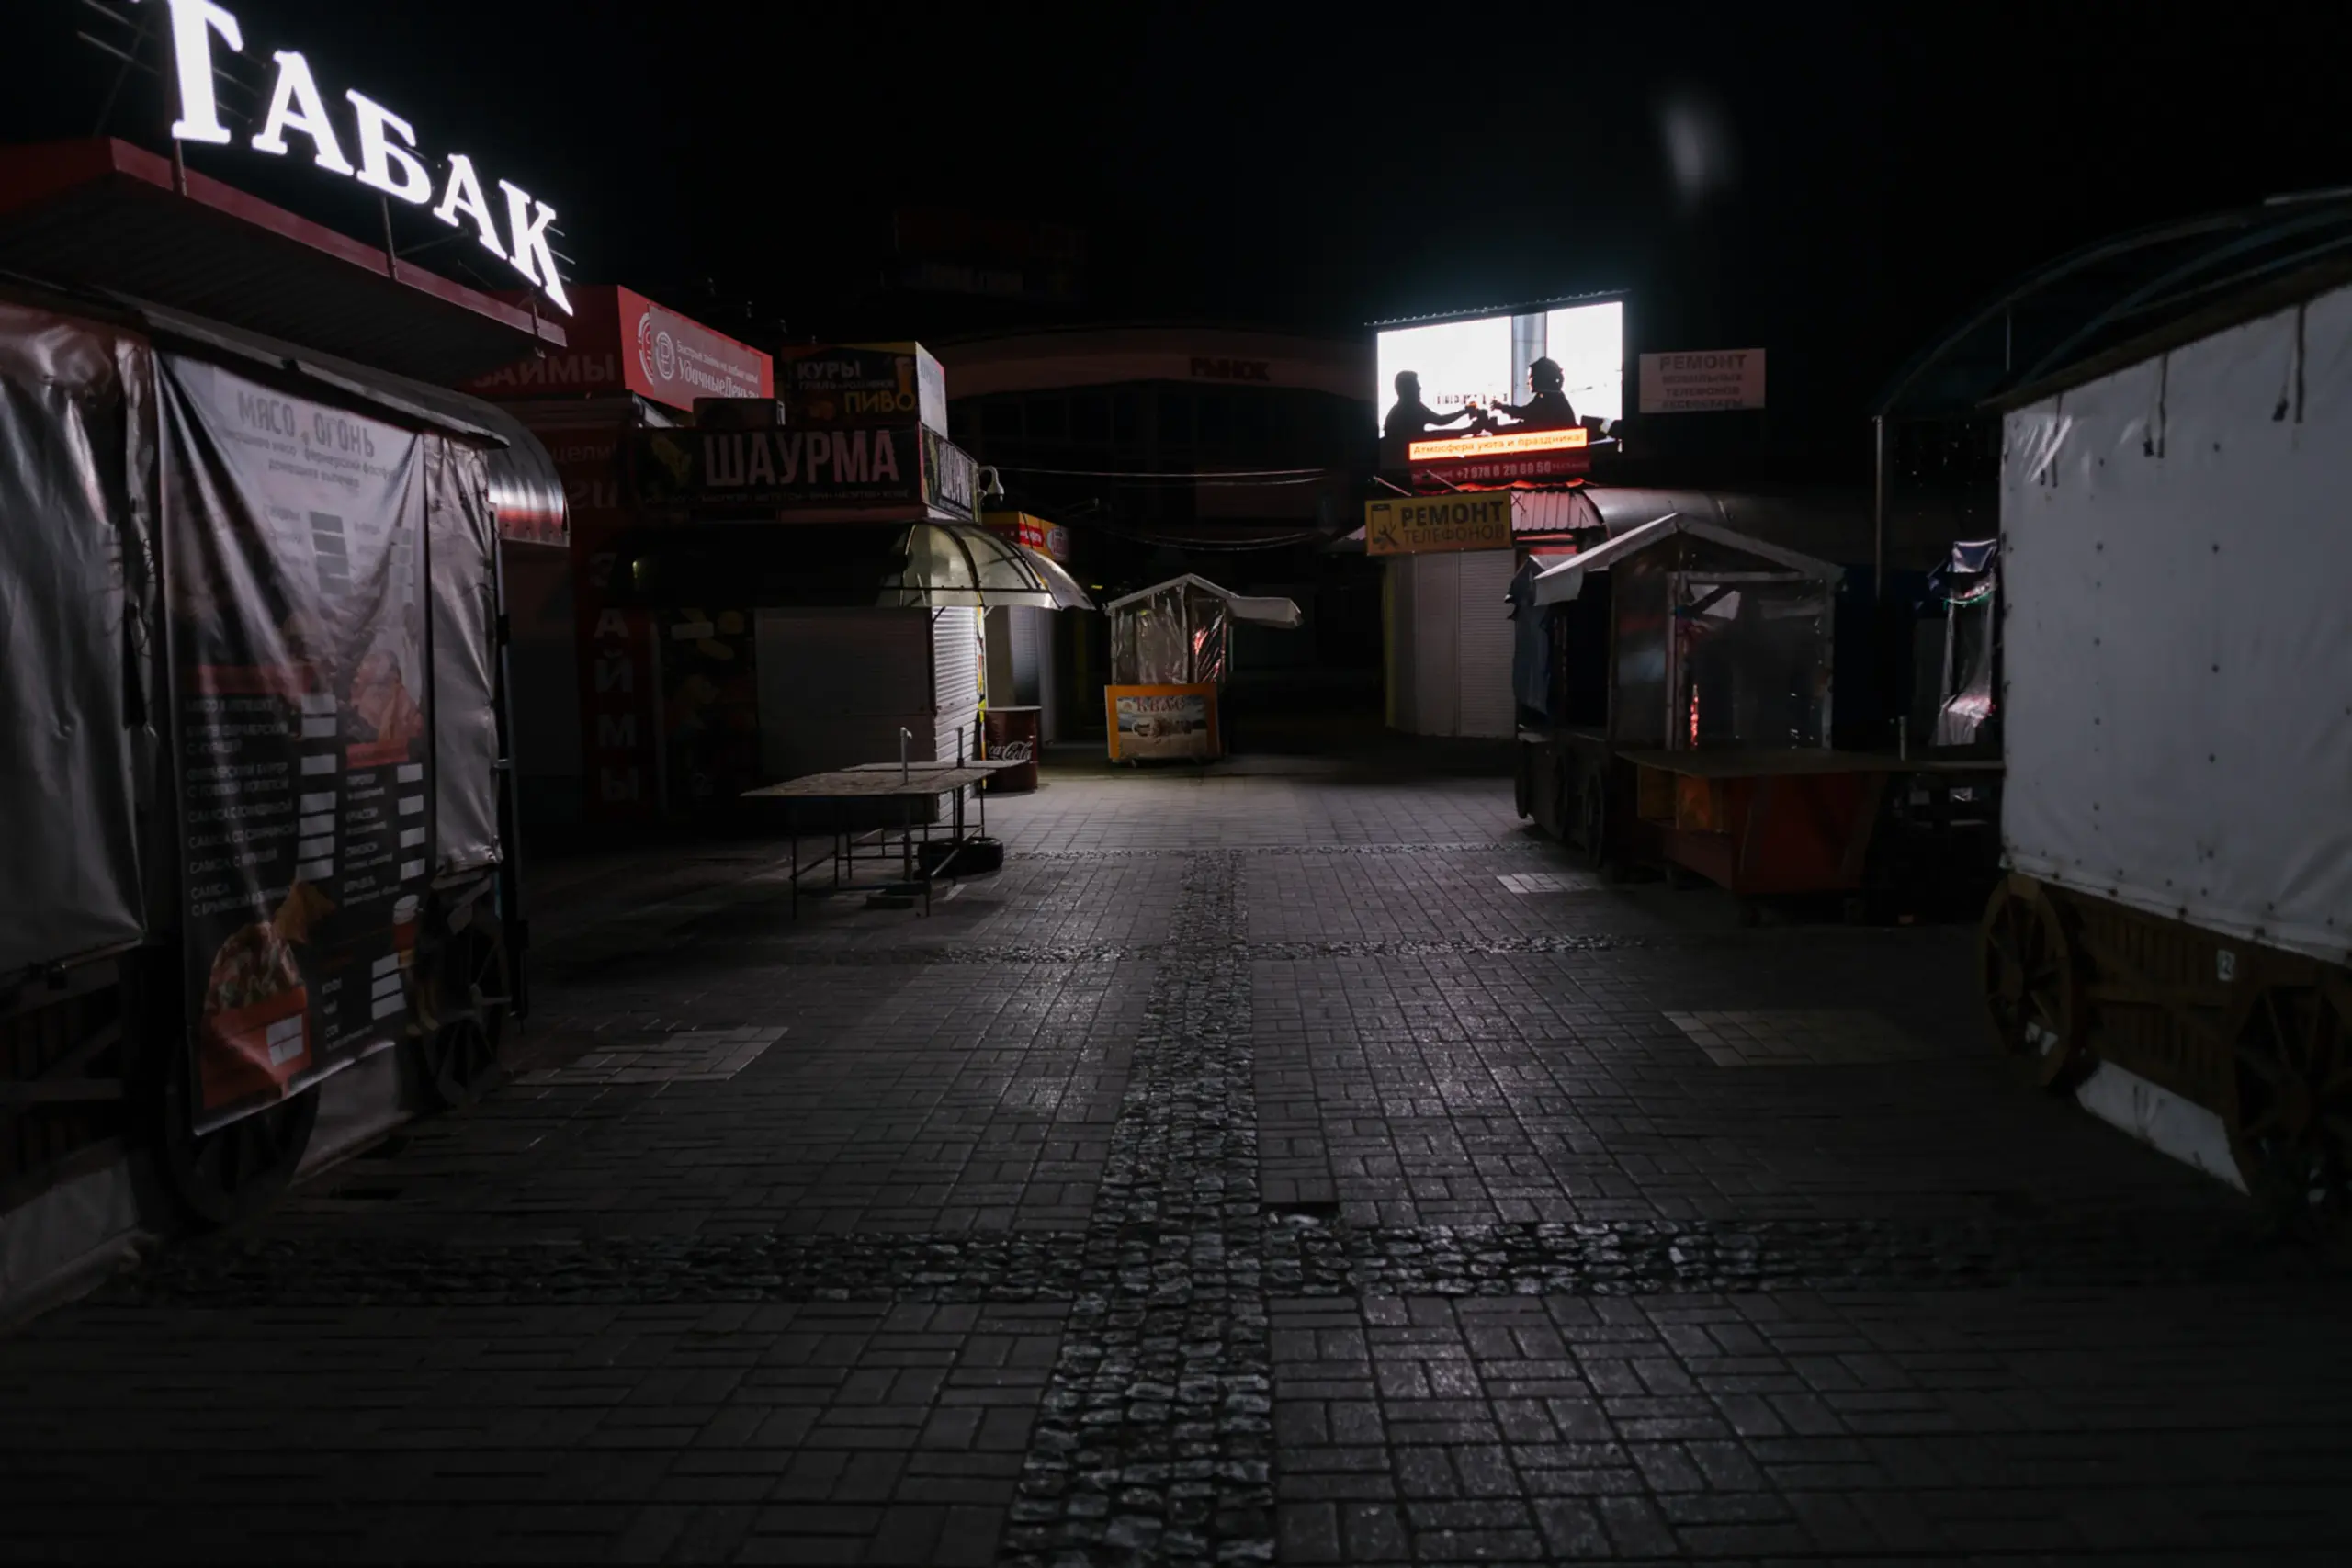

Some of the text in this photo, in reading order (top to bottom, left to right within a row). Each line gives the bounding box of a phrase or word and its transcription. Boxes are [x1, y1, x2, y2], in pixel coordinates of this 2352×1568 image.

[129, 0, 575, 316] ТАБАК
[797, 359, 862, 379] КУРЫ
[1658, 354, 1747, 371] РЕМОНТ
[236, 389, 295, 437] МЯСО
[842, 389, 916, 414] ПИВО
[703, 429, 900, 487] ШАУРМА
[1413, 443, 1475, 456] Атмосфера
[1476, 440, 1504, 452] уюта
[1400, 501, 1504, 527] РЕМОНТ
[1403, 524, 1505, 544] ТЕЛЕФОНОВ
